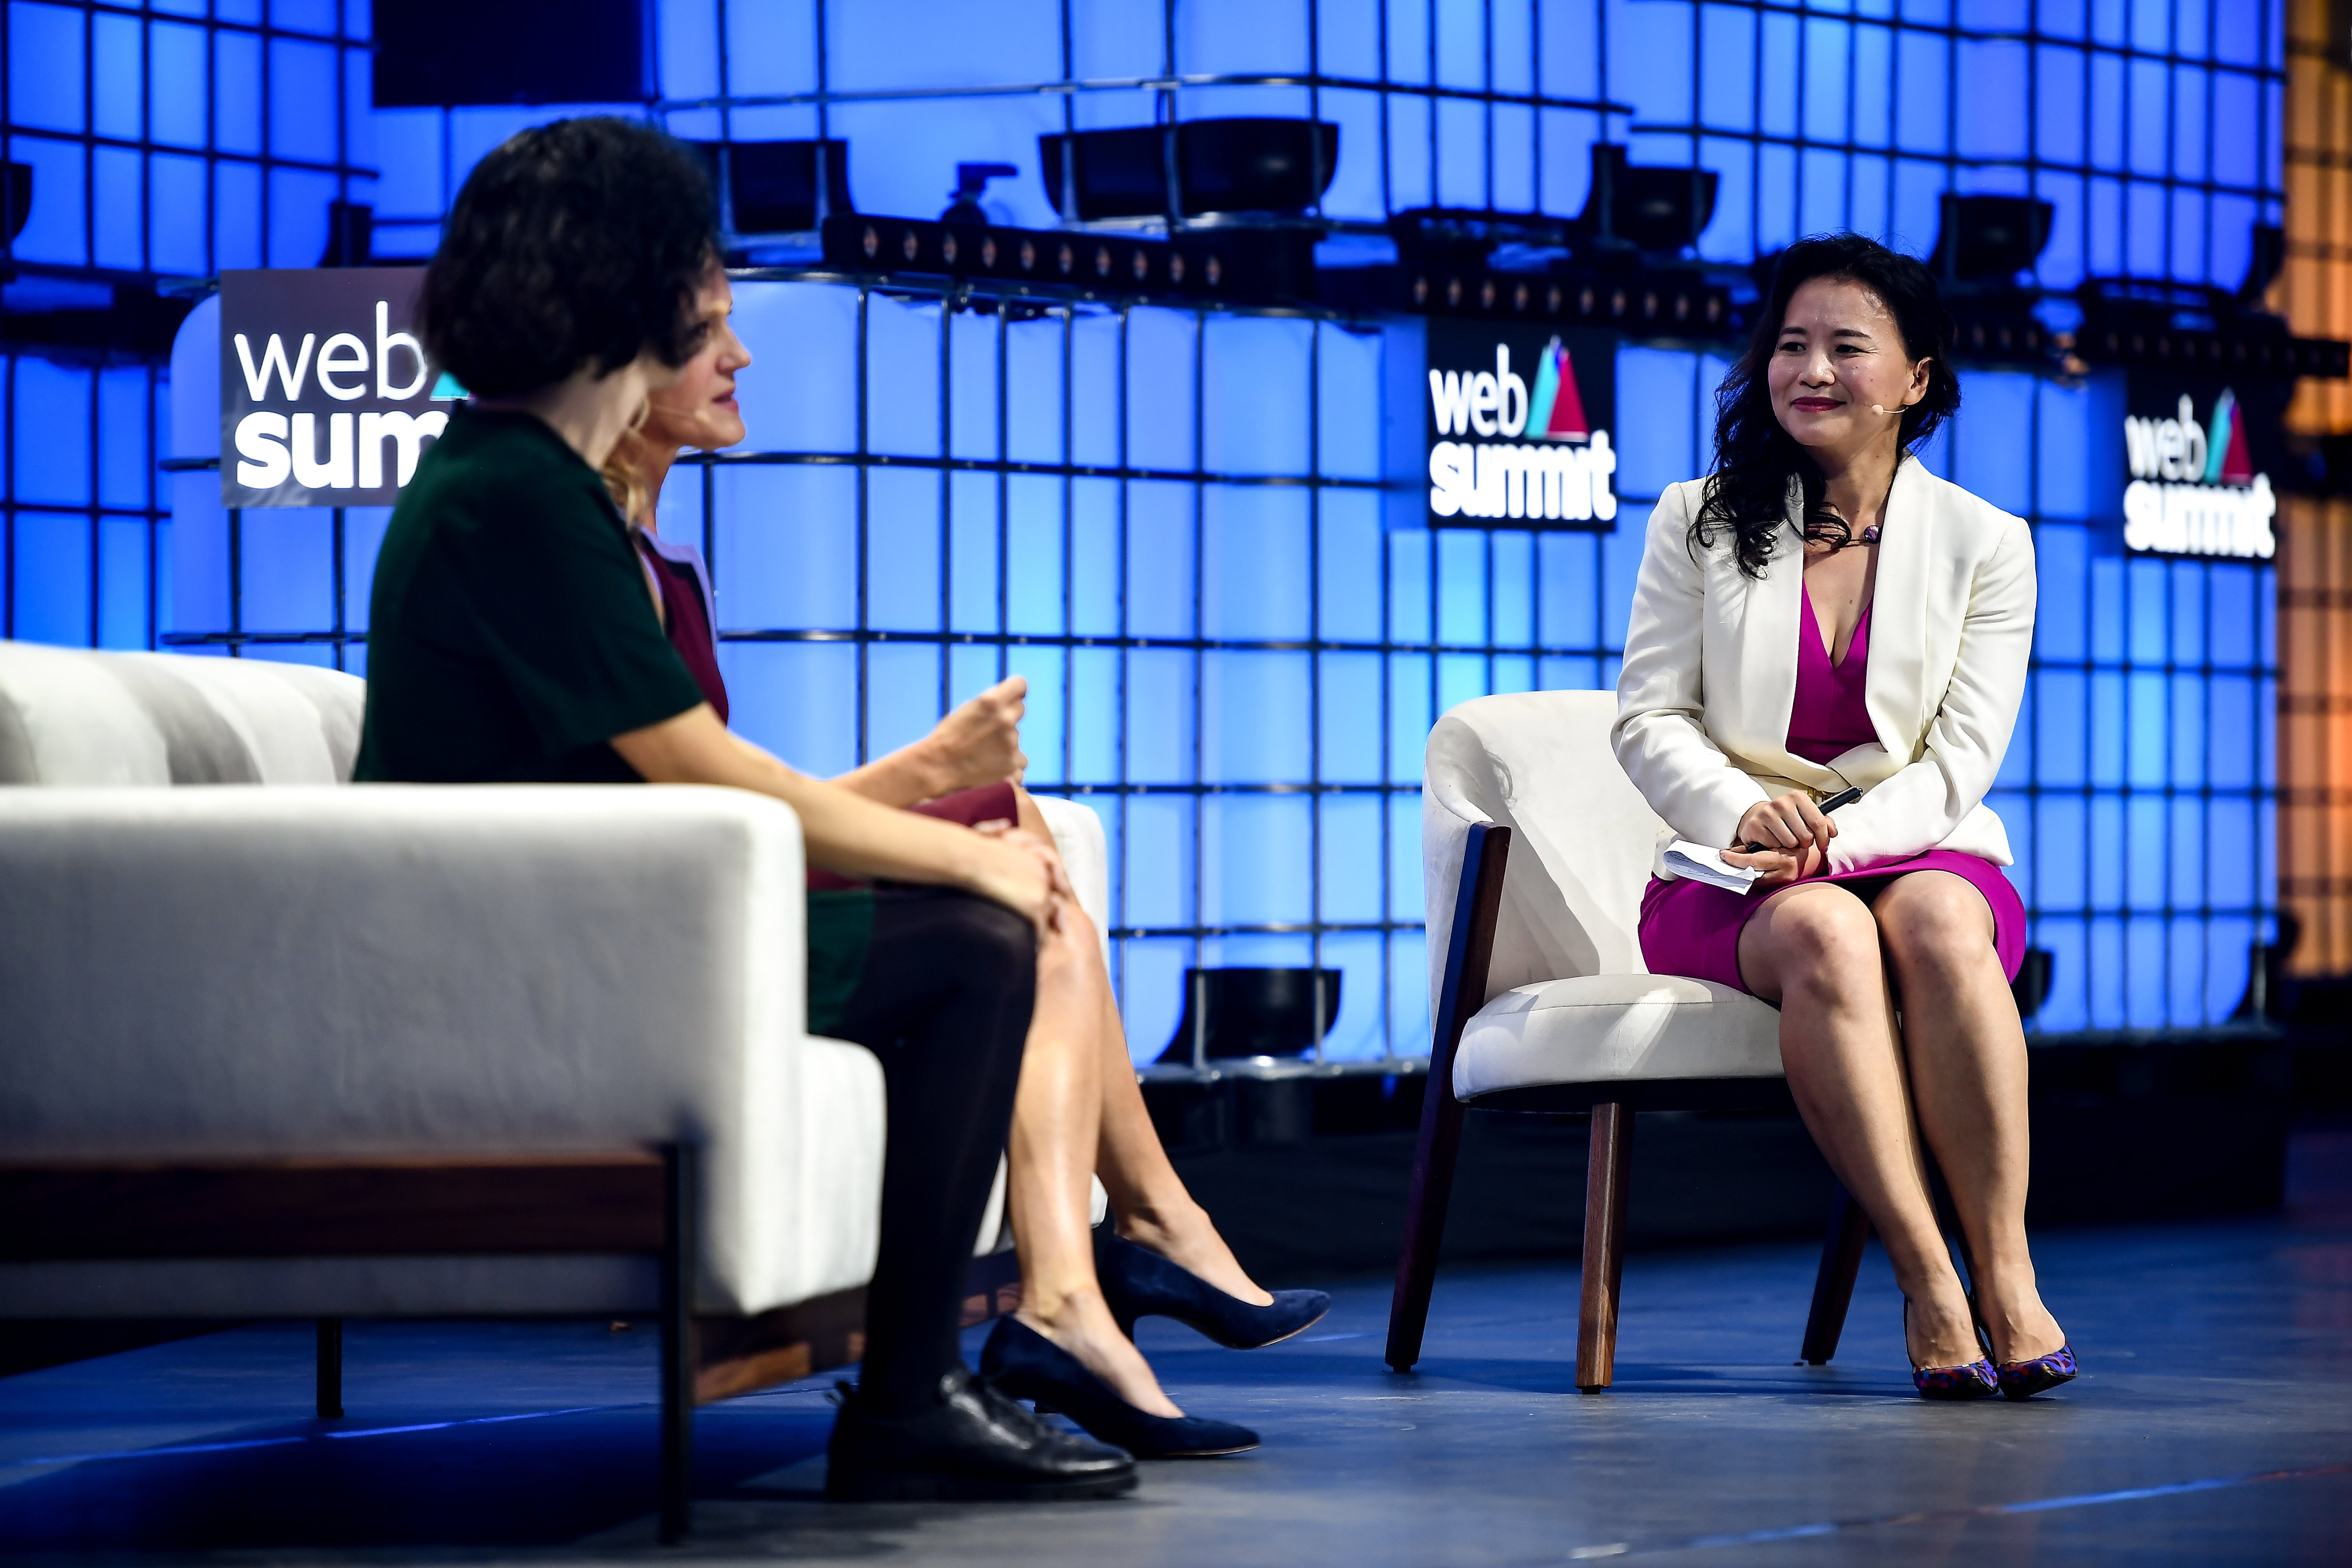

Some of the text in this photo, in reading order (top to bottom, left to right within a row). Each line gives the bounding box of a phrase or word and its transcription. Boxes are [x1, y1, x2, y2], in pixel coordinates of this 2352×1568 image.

[234, 301, 429, 401] web
[1429, 343, 1528, 438] web
[1429, 430, 1617, 521] summit
[2124, 394, 2208, 481] web
